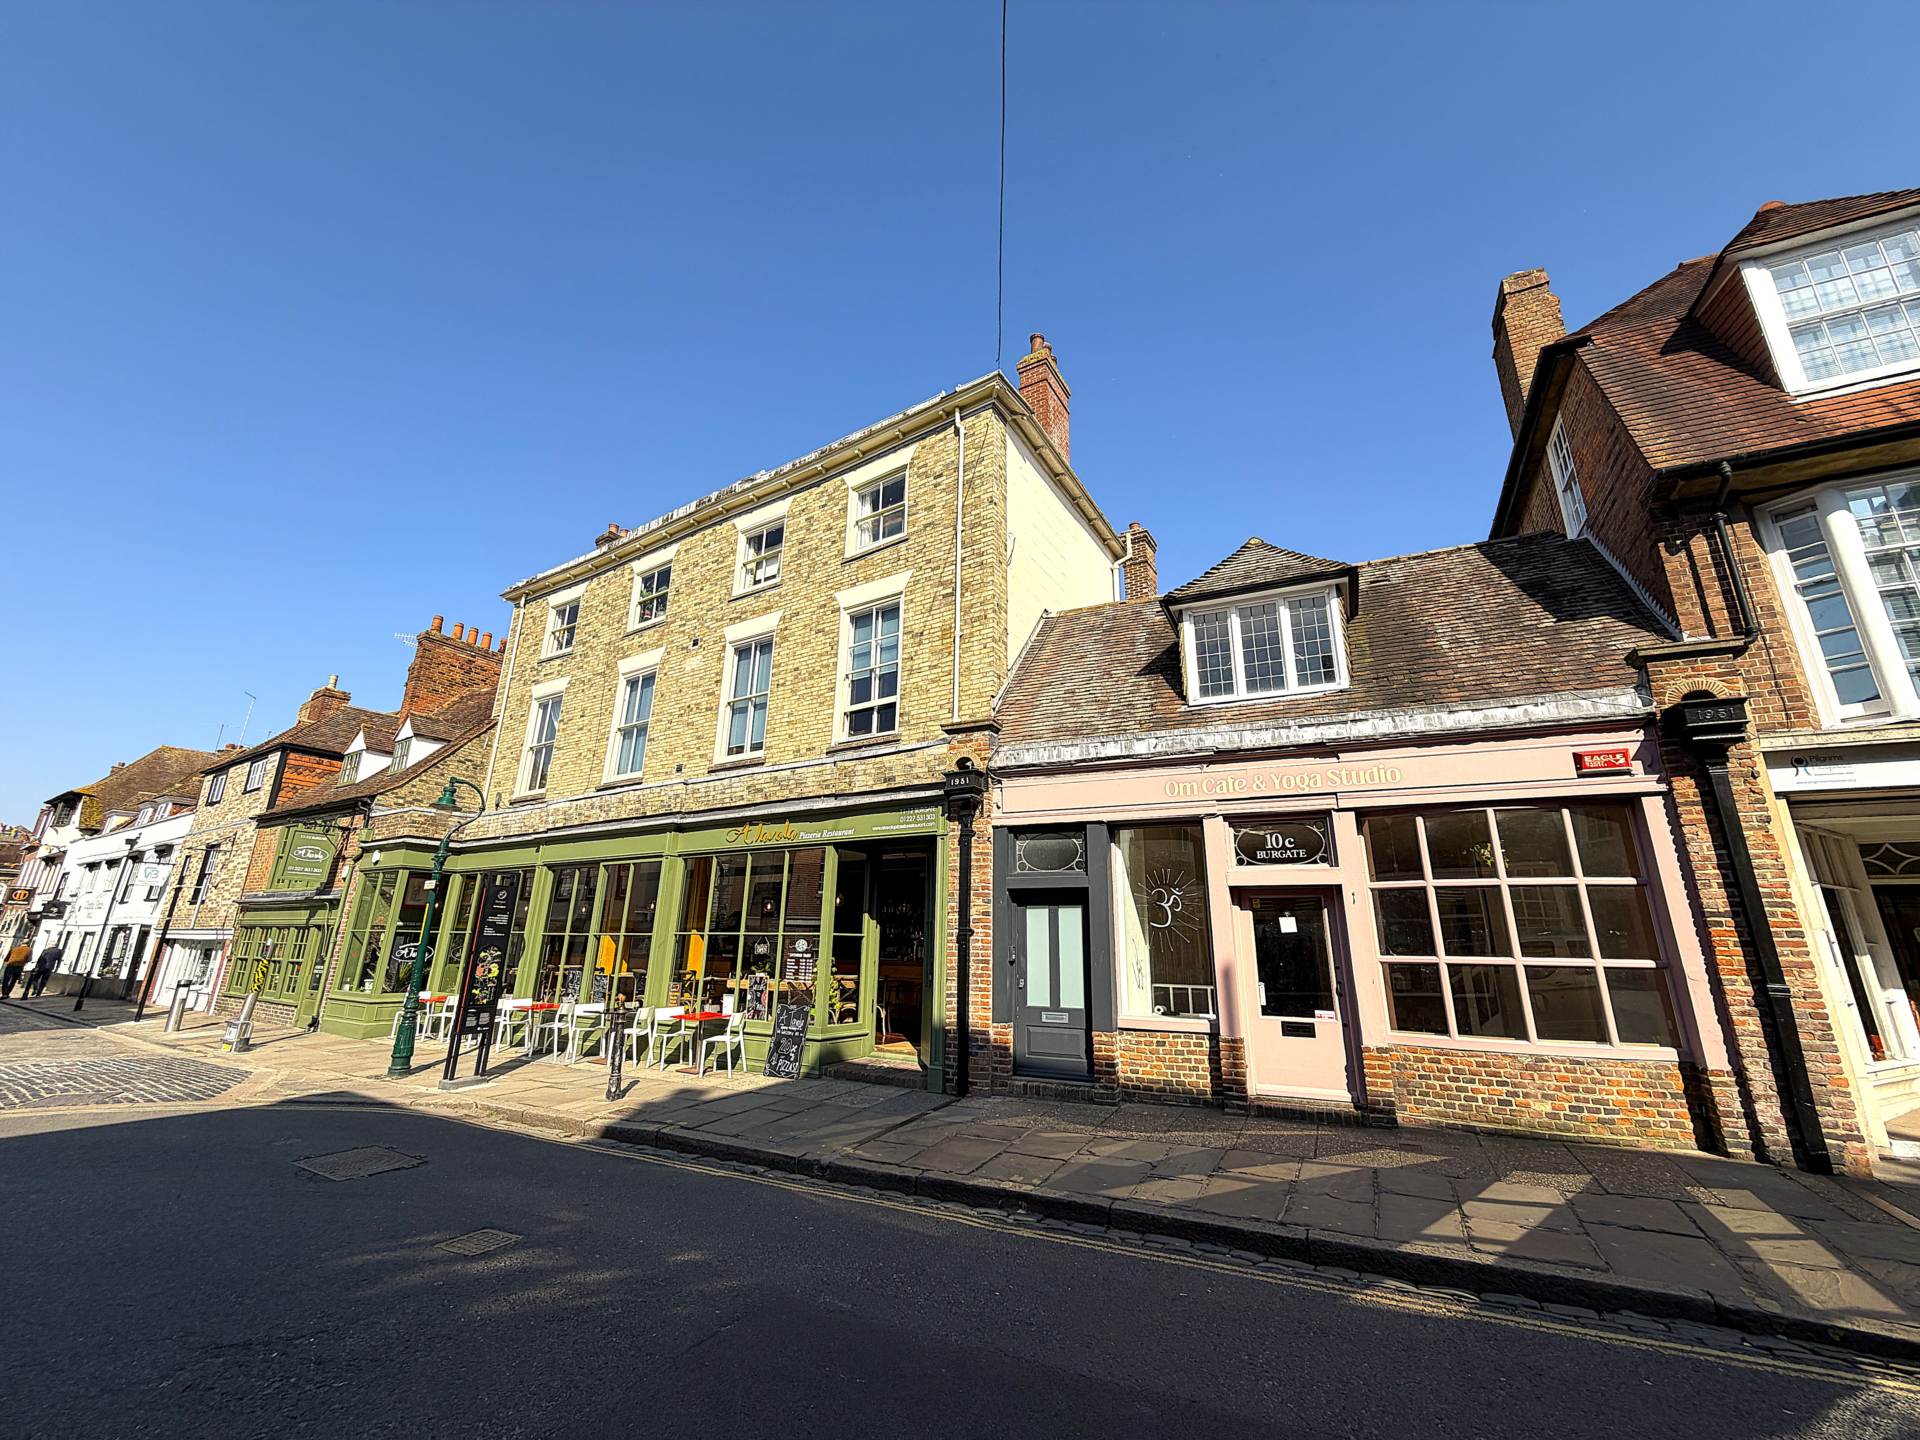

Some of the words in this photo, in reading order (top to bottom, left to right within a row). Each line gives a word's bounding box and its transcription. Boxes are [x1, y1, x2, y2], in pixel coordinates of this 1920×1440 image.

[1584, 753, 1624, 763] EAGLE
[1164, 779, 1198, 797] Om
[1202, 776, 1248, 795] Cafe
[1252, 774, 1267, 792] &
[1270, 770, 1322, 793] Yoga
[1327, 764, 1402, 786] Studio
[822, 827, 855, 838] Restaurant
[1256, 849, 1307, 859] BURGATE
